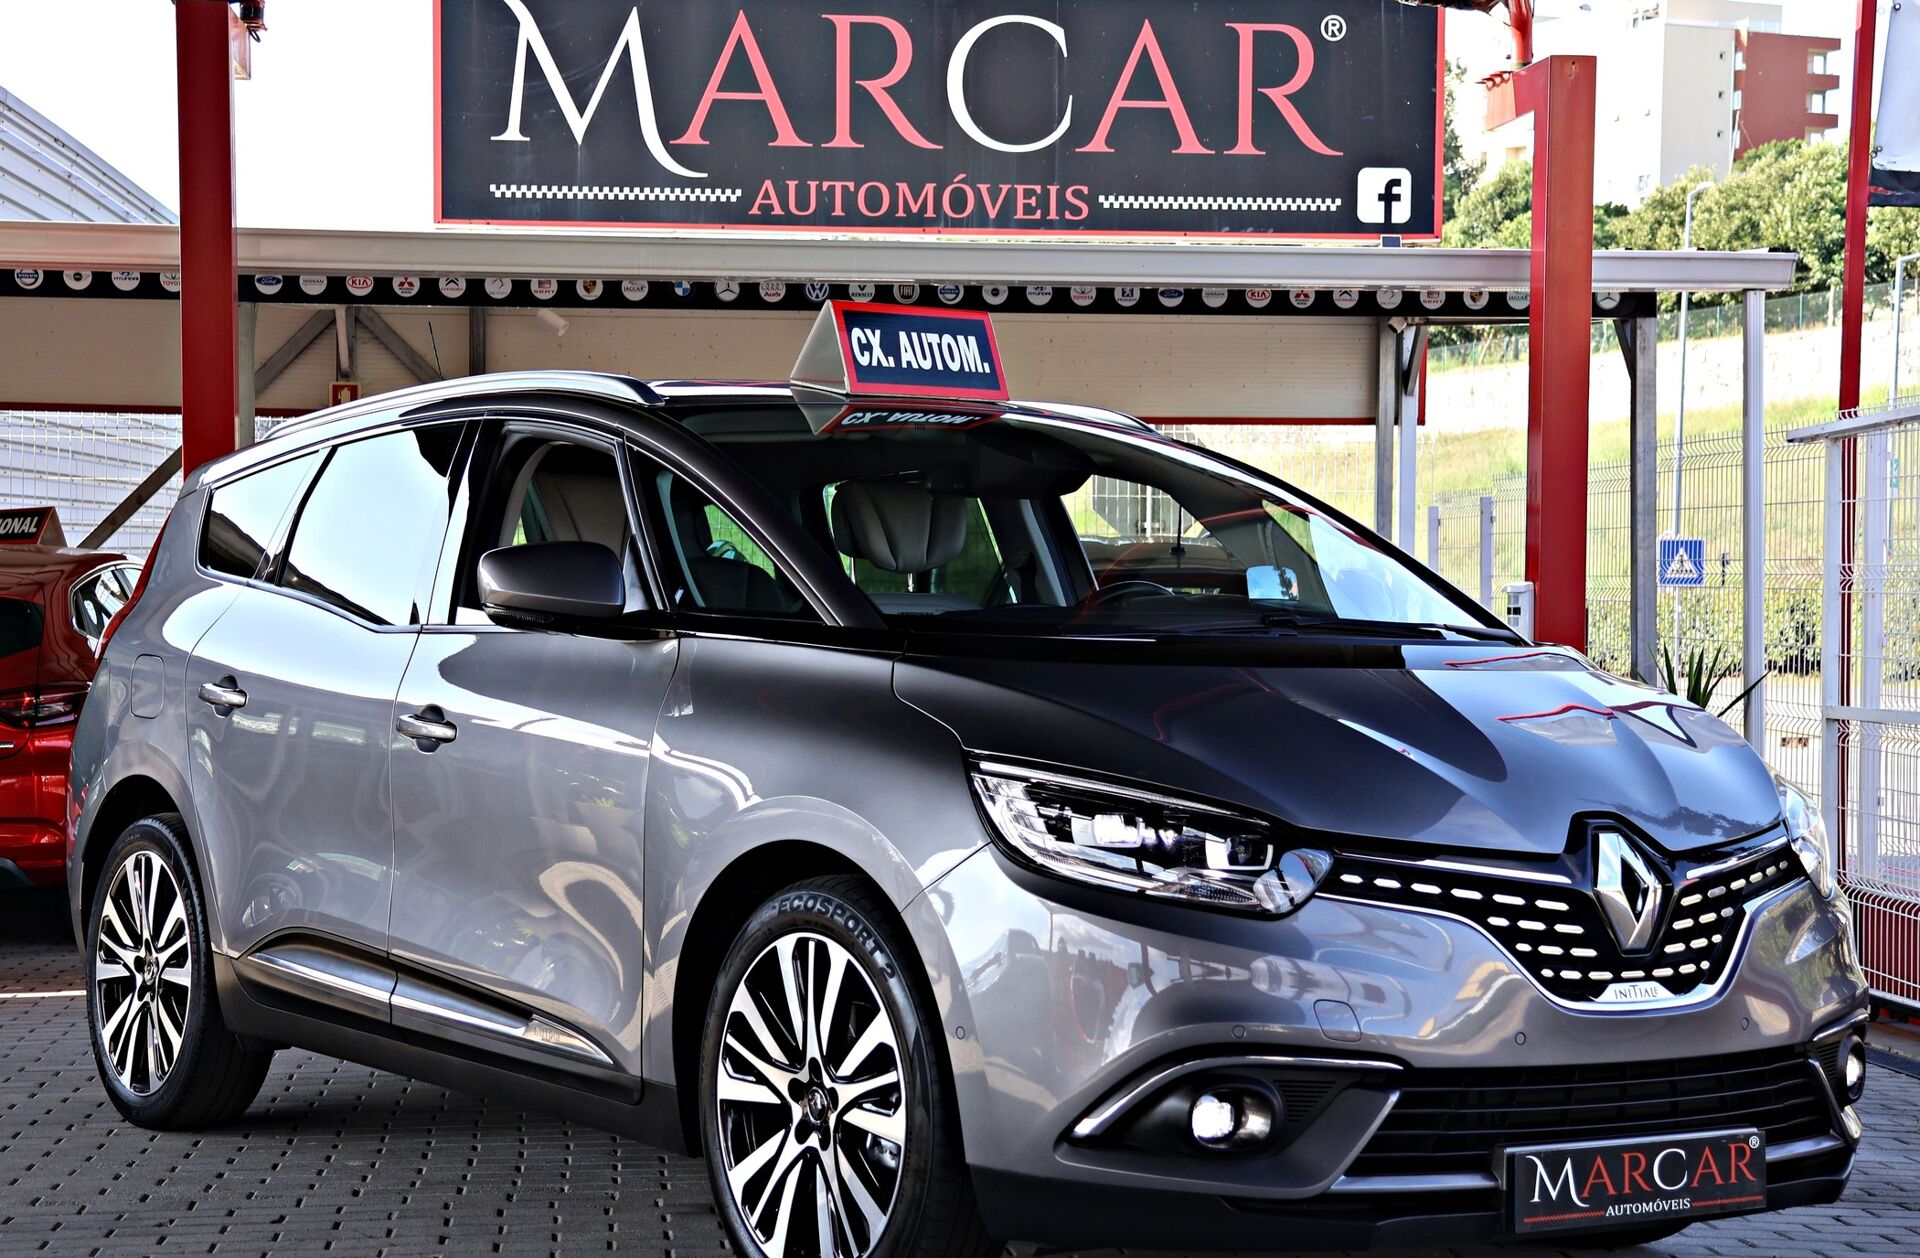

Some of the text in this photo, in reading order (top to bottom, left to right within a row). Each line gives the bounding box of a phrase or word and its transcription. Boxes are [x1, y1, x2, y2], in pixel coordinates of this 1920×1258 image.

[748, 173, 1090, 221] AUTOMÓVEIS
[351, 279, 369, 287] KIA
[851, 327, 991, 374] CX. AUTOM.
[778, 895, 884, 957] ECOSPORT
[1605, 1198, 1692, 1217] AUTOMÓVEIS
